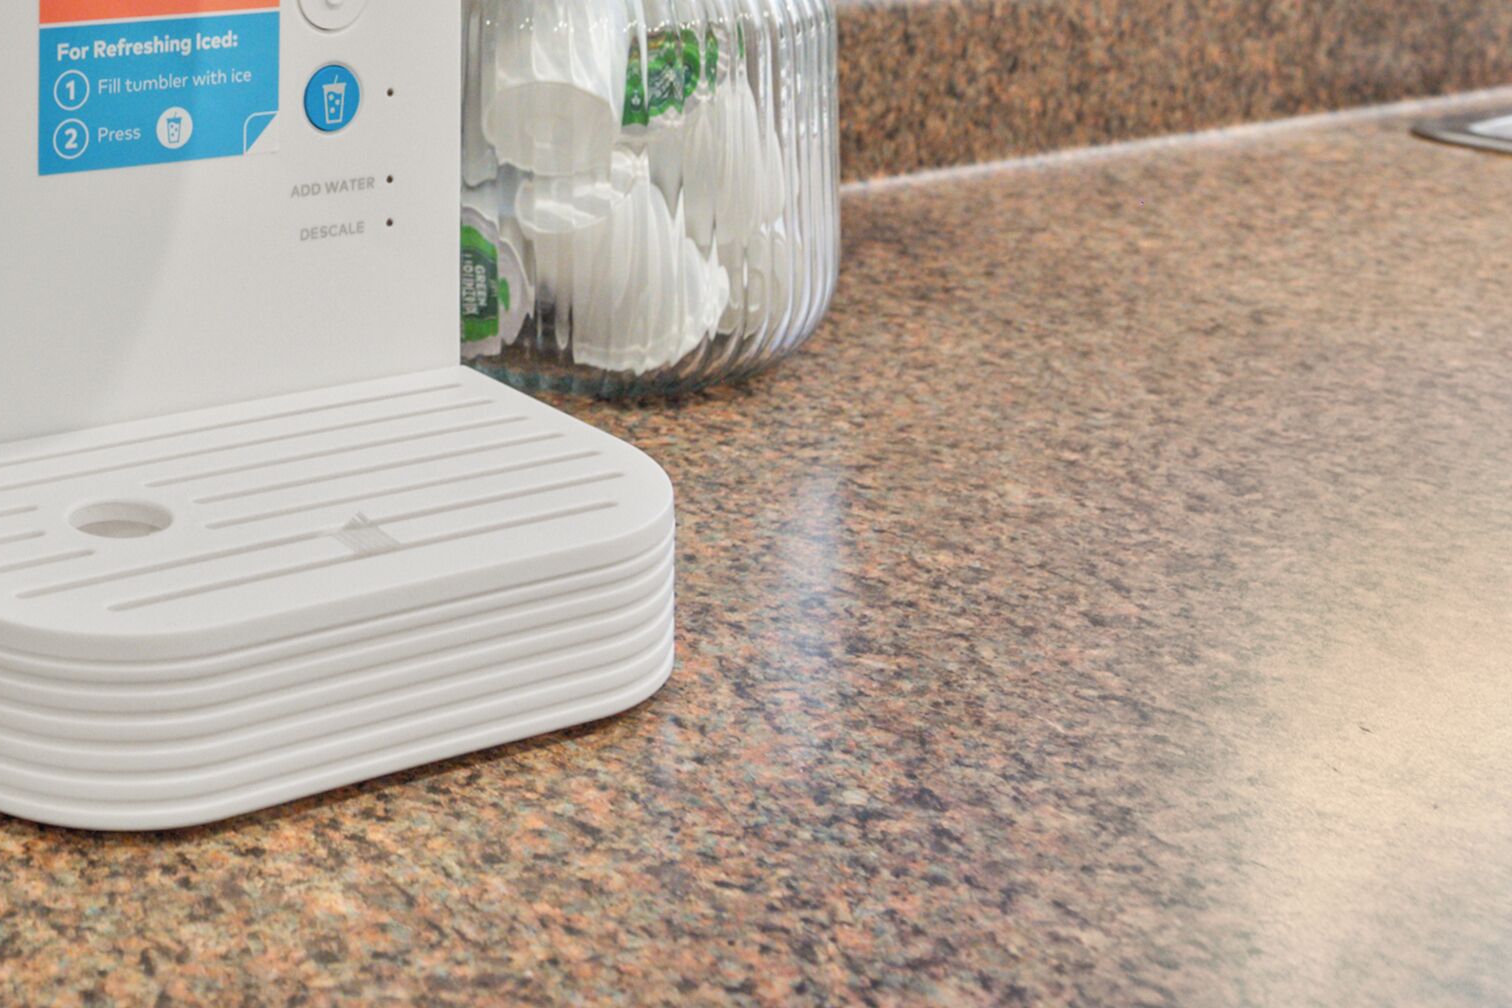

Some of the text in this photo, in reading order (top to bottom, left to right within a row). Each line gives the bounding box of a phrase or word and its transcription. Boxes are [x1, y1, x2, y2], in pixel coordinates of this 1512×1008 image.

[57, 30, 238, 61] For Refreshing Iced:
[65, 80, 75, 101] 1
[98, 68, 252, 95] Fill tumbler with ice
[65, 128, 78, 149] 2
[98, 127, 141, 143] Press
[291, 177, 375, 198] ADD WATER
[300, 221, 365, 241] DESCALE
